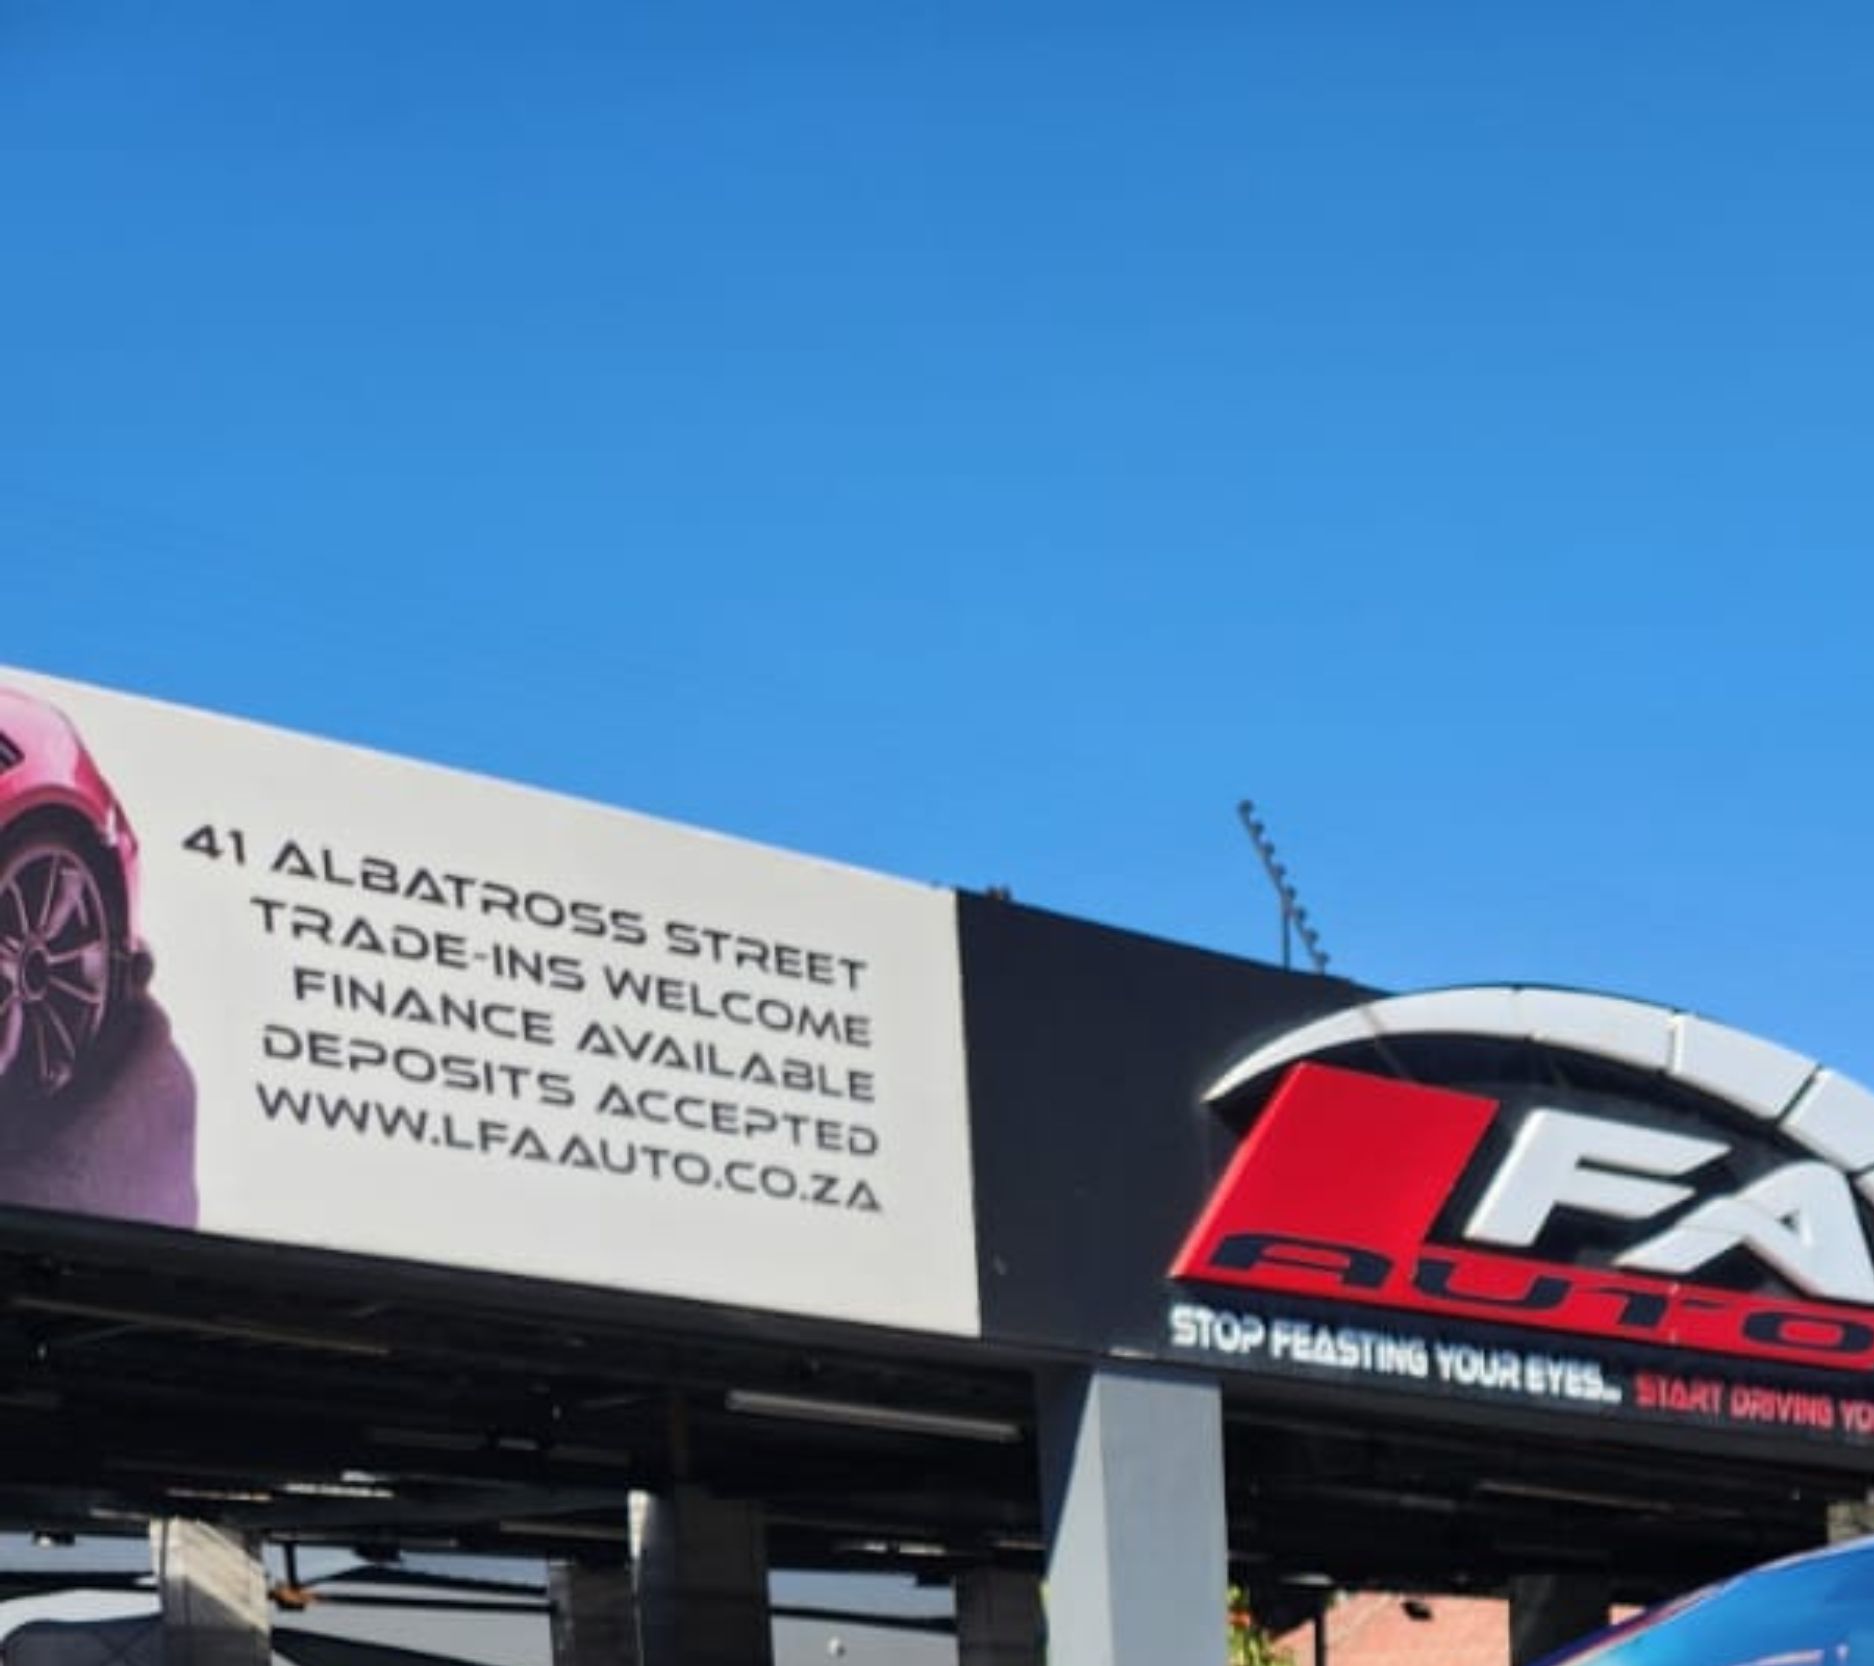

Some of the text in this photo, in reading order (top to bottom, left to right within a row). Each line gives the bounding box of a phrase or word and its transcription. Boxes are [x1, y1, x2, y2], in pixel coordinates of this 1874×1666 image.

[181, 823, 870, 992] 41 ALBATROSS STREET
[250, 896, 873, 1049] TRADE-INS WELCOME
[262, 1023, 881, 1158] DEPOSITS ACCEPTED
[293, 966, 876, 1104] FINANCE AVAILABLE
[256, 1083, 884, 1213] WWW.LFAAUTO.CO.ZA
[1169, 1303, 1266, 1356] STOP
[1270, 1318, 1430, 1380] FEASTING
[1434, 1341, 1520, 1390] YOUR
[1634, 1374, 1723, 1416] START
[1730, 1384, 1836, 1431] DRIVING
